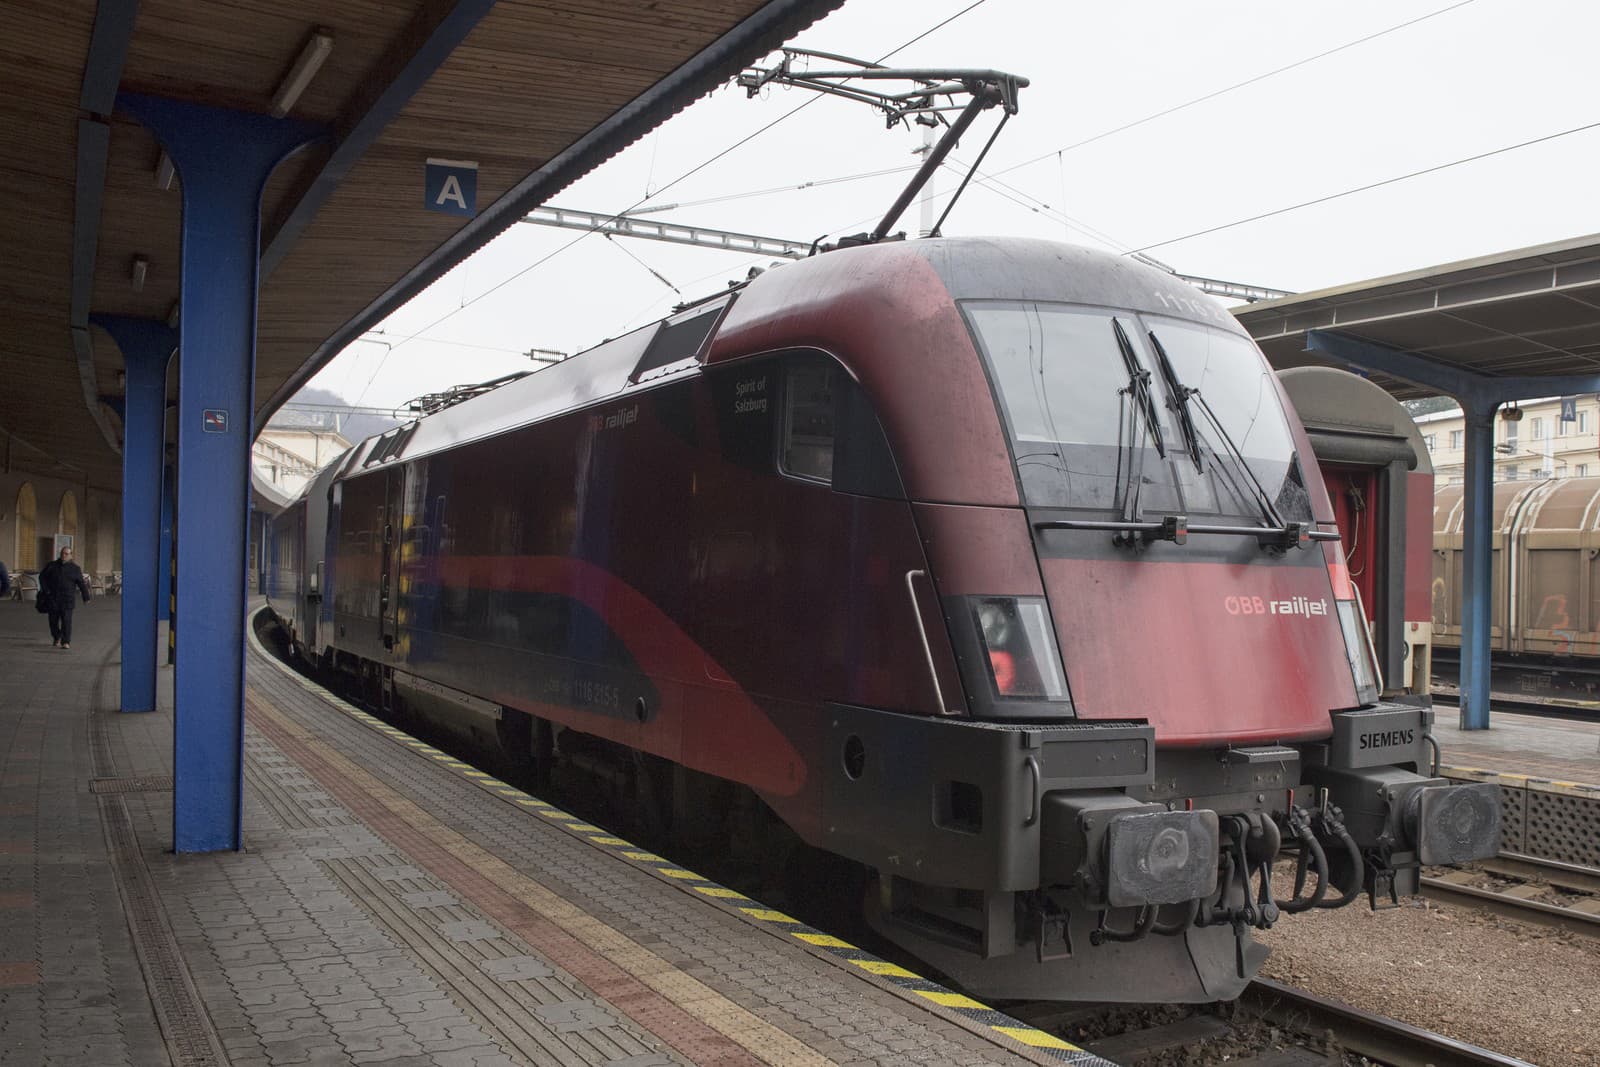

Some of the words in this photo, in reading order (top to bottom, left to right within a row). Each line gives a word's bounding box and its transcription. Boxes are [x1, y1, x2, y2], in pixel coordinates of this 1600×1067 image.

[435, 175, 467, 209] A
[735, 378, 756, 397] Spirit
[757, 376, 768, 391] of
[735, 397, 767, 413] Salzburg
[1564, 402, 1574, 418] A
[605, 404, 638, 429] railjet
[1269, 596, 1328, 619] railjet
[1359, 728, 1414, 750] SIEMENS
